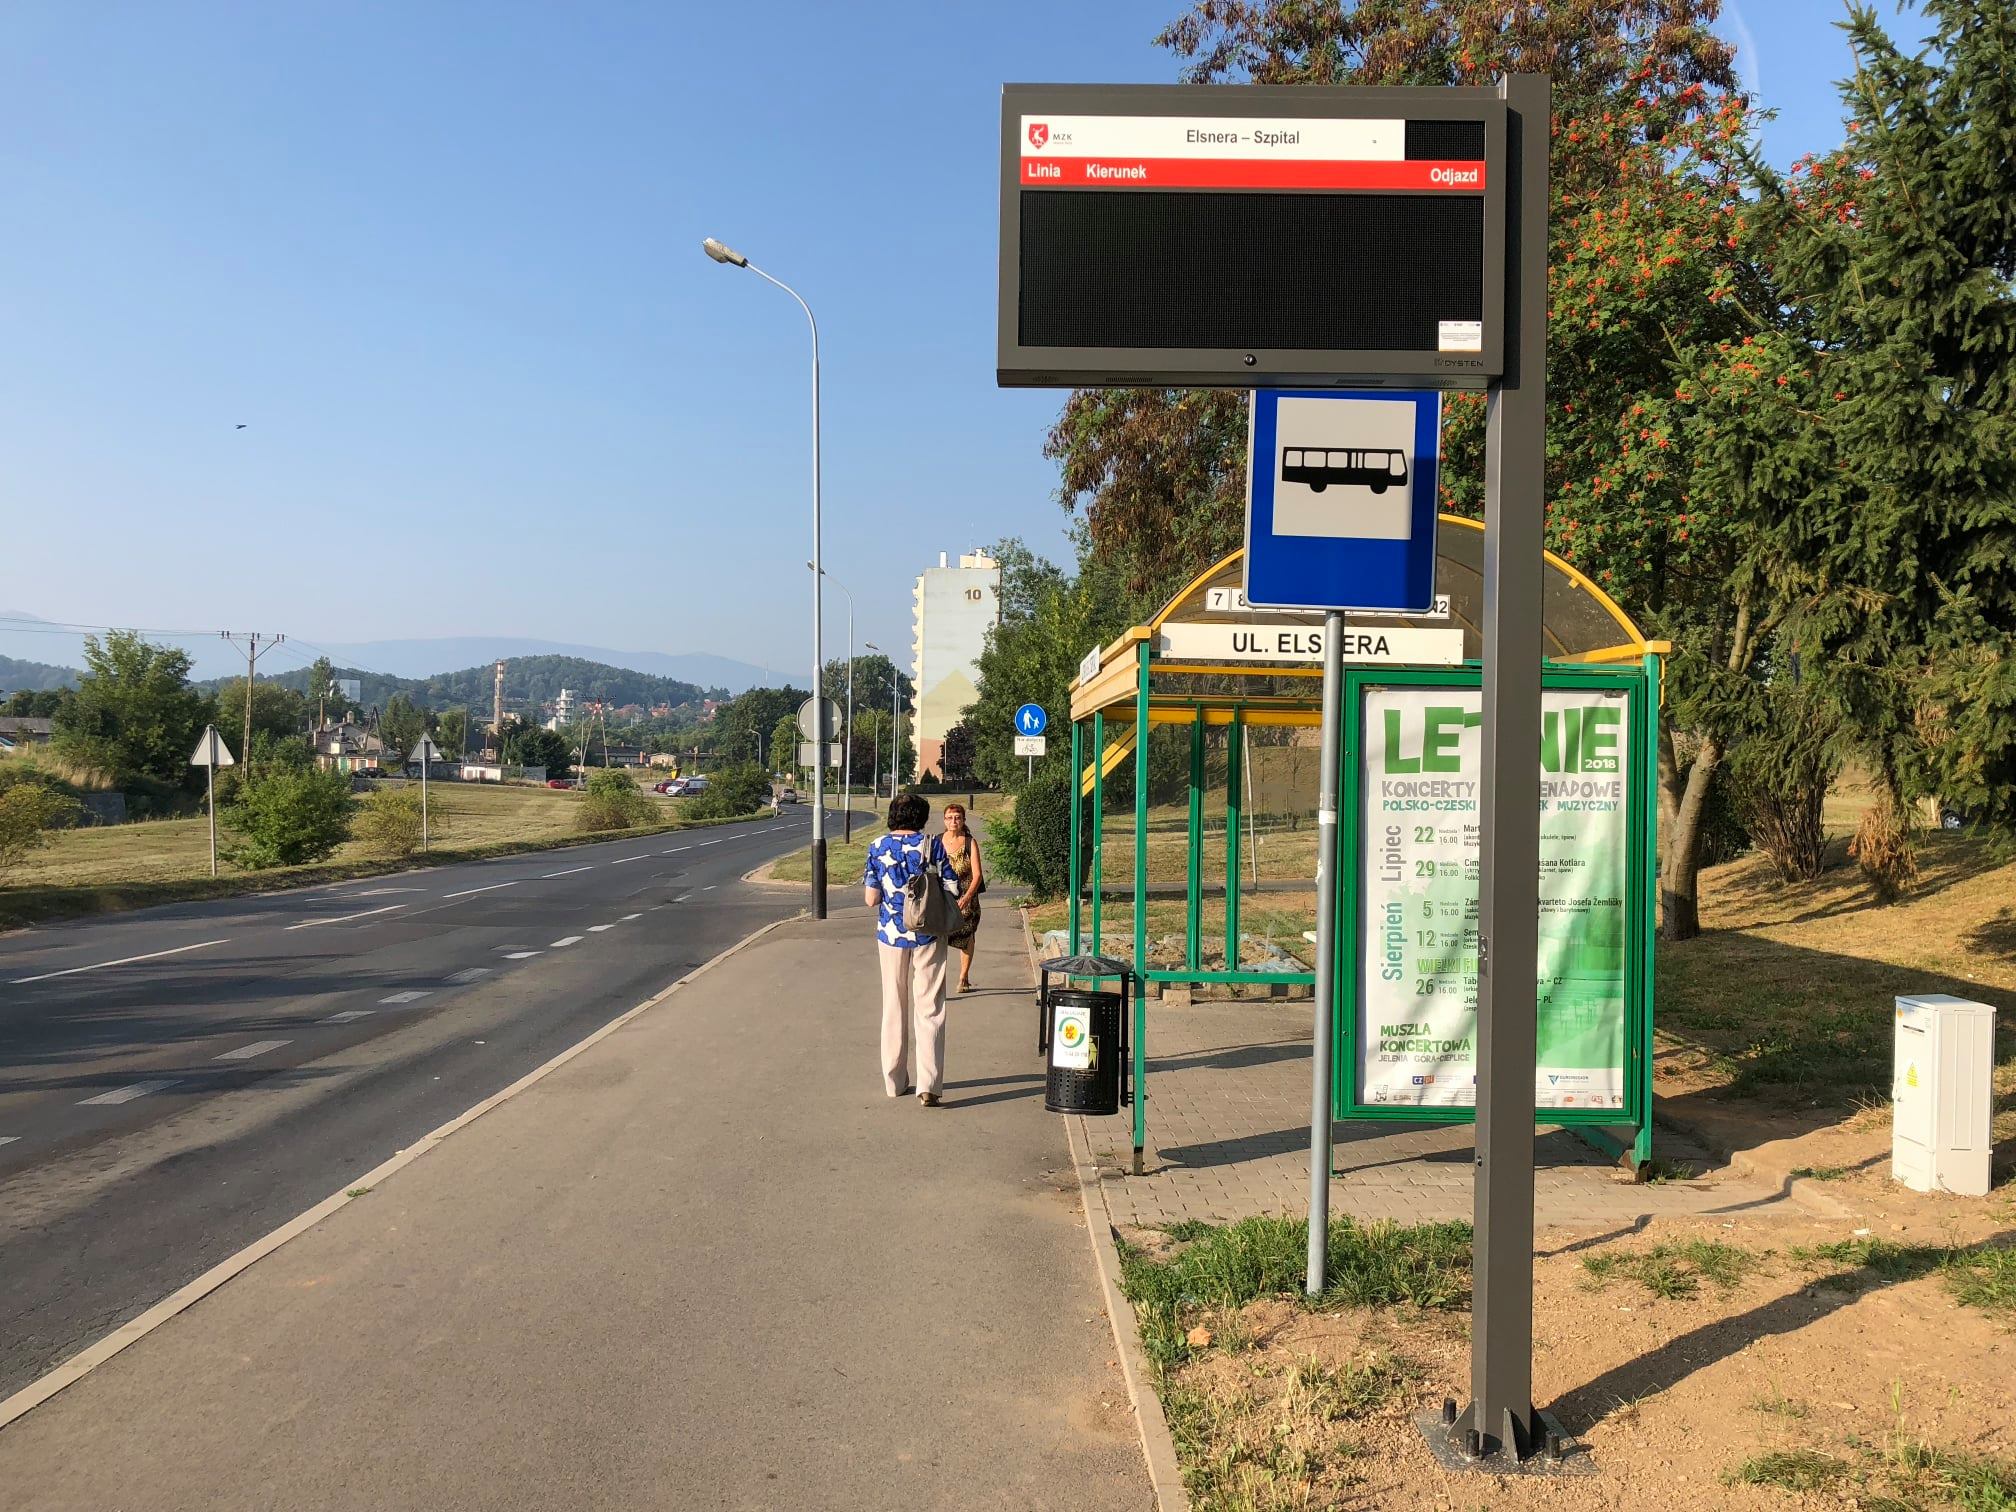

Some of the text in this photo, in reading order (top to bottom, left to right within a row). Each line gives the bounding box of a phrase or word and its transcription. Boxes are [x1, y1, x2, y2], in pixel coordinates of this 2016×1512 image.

[1052, 133, 1072, 141] MZK
[1186, 129, 1238, 144] Elsnera
[1254, 130, 1300, 147] Szpital
[1028, 163, 1147, 179] Linia Kierunek
[1430, 167, 1478, 186] Odjazd
[1444, 359, 1484, 367] DYSTEN
[964, 588, 982, 600] 10
[1214, 592, 1223, 606] 7
[1233, 633, 1390, 655] UL. ELSERA
[1584, 758, 1616, 769] 2018
[1381, 780, 1476, 798] KONCERTY
[1382, 799, 1476, 811] POLSKO-CZESKI
[1557, 800, 1619, 811] MUZYCZNY
[1414, 825, 1435, 843] 22
[1439, 836, 1458, 844] 16.00
[1379, 825, 1407, 882] Lipiec
[1415, 860, 1435, 877] 29
[1440, 869, 1459, 877] 16.00
[1422, 900, 1432, 917] 5
[1568, 897, 1592, 906] Josefa
[1441, 908, 1459, 916] 16.00
[1380, 902, 1408, 981] Sierpień
[1416, 929, 1436, 947] 12
[1415, 978, 1434, 995] 26
[1553, 976, 1563, 985] CZ
[1543, 995, 1552, 1004] PL
[1380, 1022, 1431, 1037] MUSZLA
[1379, 1038, 1471, 1053] KONCERTOWA
[1378, 1054, 1408, 1063] JELENIA
